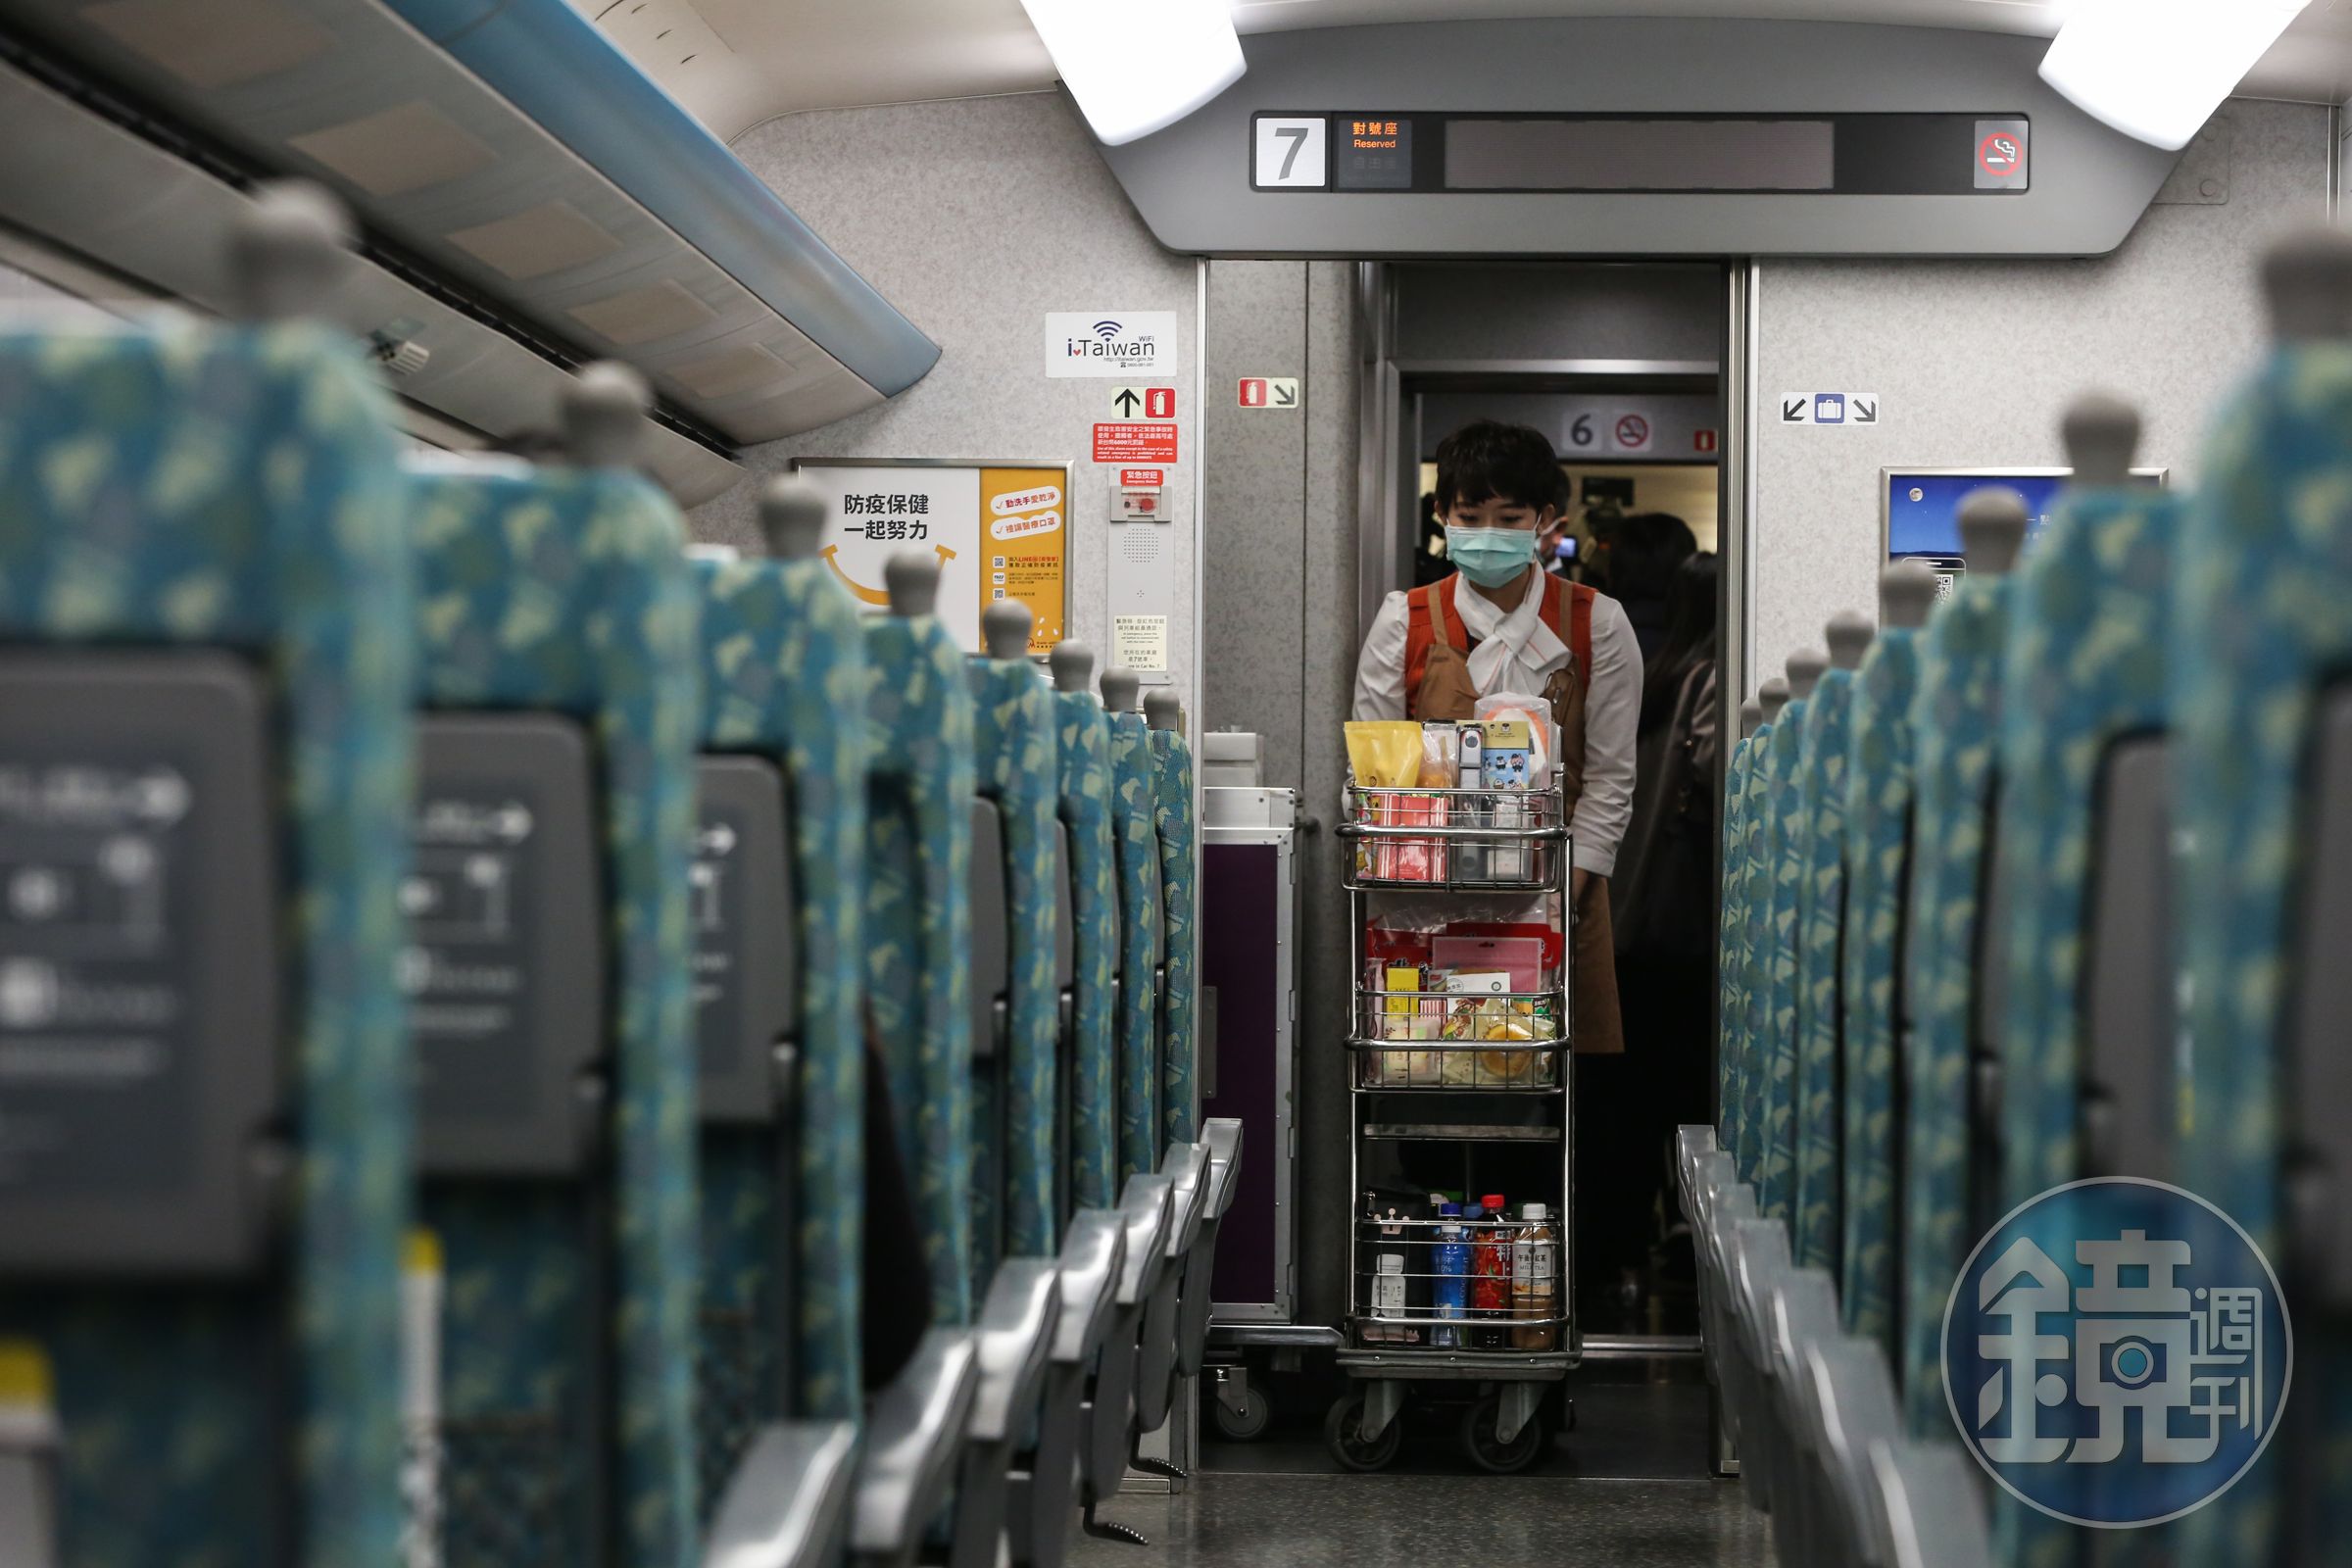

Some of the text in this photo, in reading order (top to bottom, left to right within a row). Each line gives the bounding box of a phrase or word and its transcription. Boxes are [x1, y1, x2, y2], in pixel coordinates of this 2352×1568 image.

[1352, 122, 1398, 135] 對號座
[1353, 139, 1397, 148] Reserved
[1275, 127, 1309, 180] 7
[1570, 414, 1593, 446] 6
[845, 494, 929, 514] 防疫保健
[845, 520, 928, 539] 一起努力
